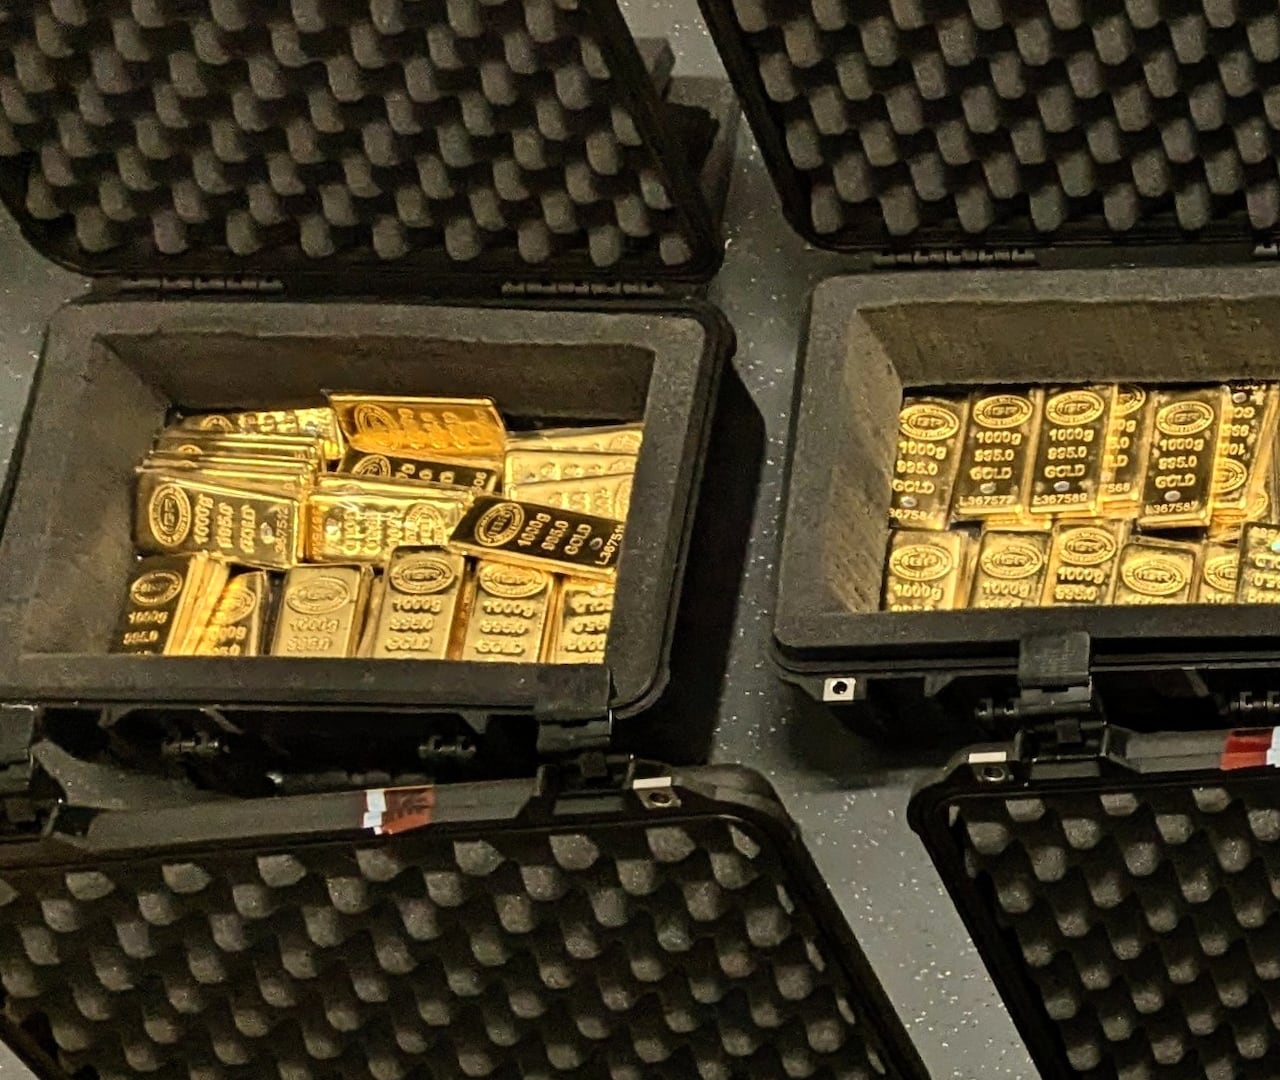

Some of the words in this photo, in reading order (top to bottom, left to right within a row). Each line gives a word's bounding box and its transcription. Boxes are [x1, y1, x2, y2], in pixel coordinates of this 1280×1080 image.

[976, 431, 1021, 445] 1000g
[1049, 428, 1094, 441] 1000g
[899, 441, 946, 460] 1000g
[1160, 438, 1204, 451] 1000g
[974, 449, 1014, 462] 995.0
[1048, 446, 1087, 459] 995.0
[896, 461, 938, 475] 995.0
[1158, 456, 1197, 469] 995.0
[970, 466, 1012, 480] GOLD
[1045, 464, 1085, 477] GOLD
[893, 480, 935, 494] GOLD
[1155, 474, 1196, 488] GOLD
[518, 512, 551, 547] 1000g
[565, 524, 592, 555] GOLD
[1058, 567, 1104, 583] 1000g
[894, 583, 943, 599] 1000g
[1055, 586, 1097, 600] 995.0
